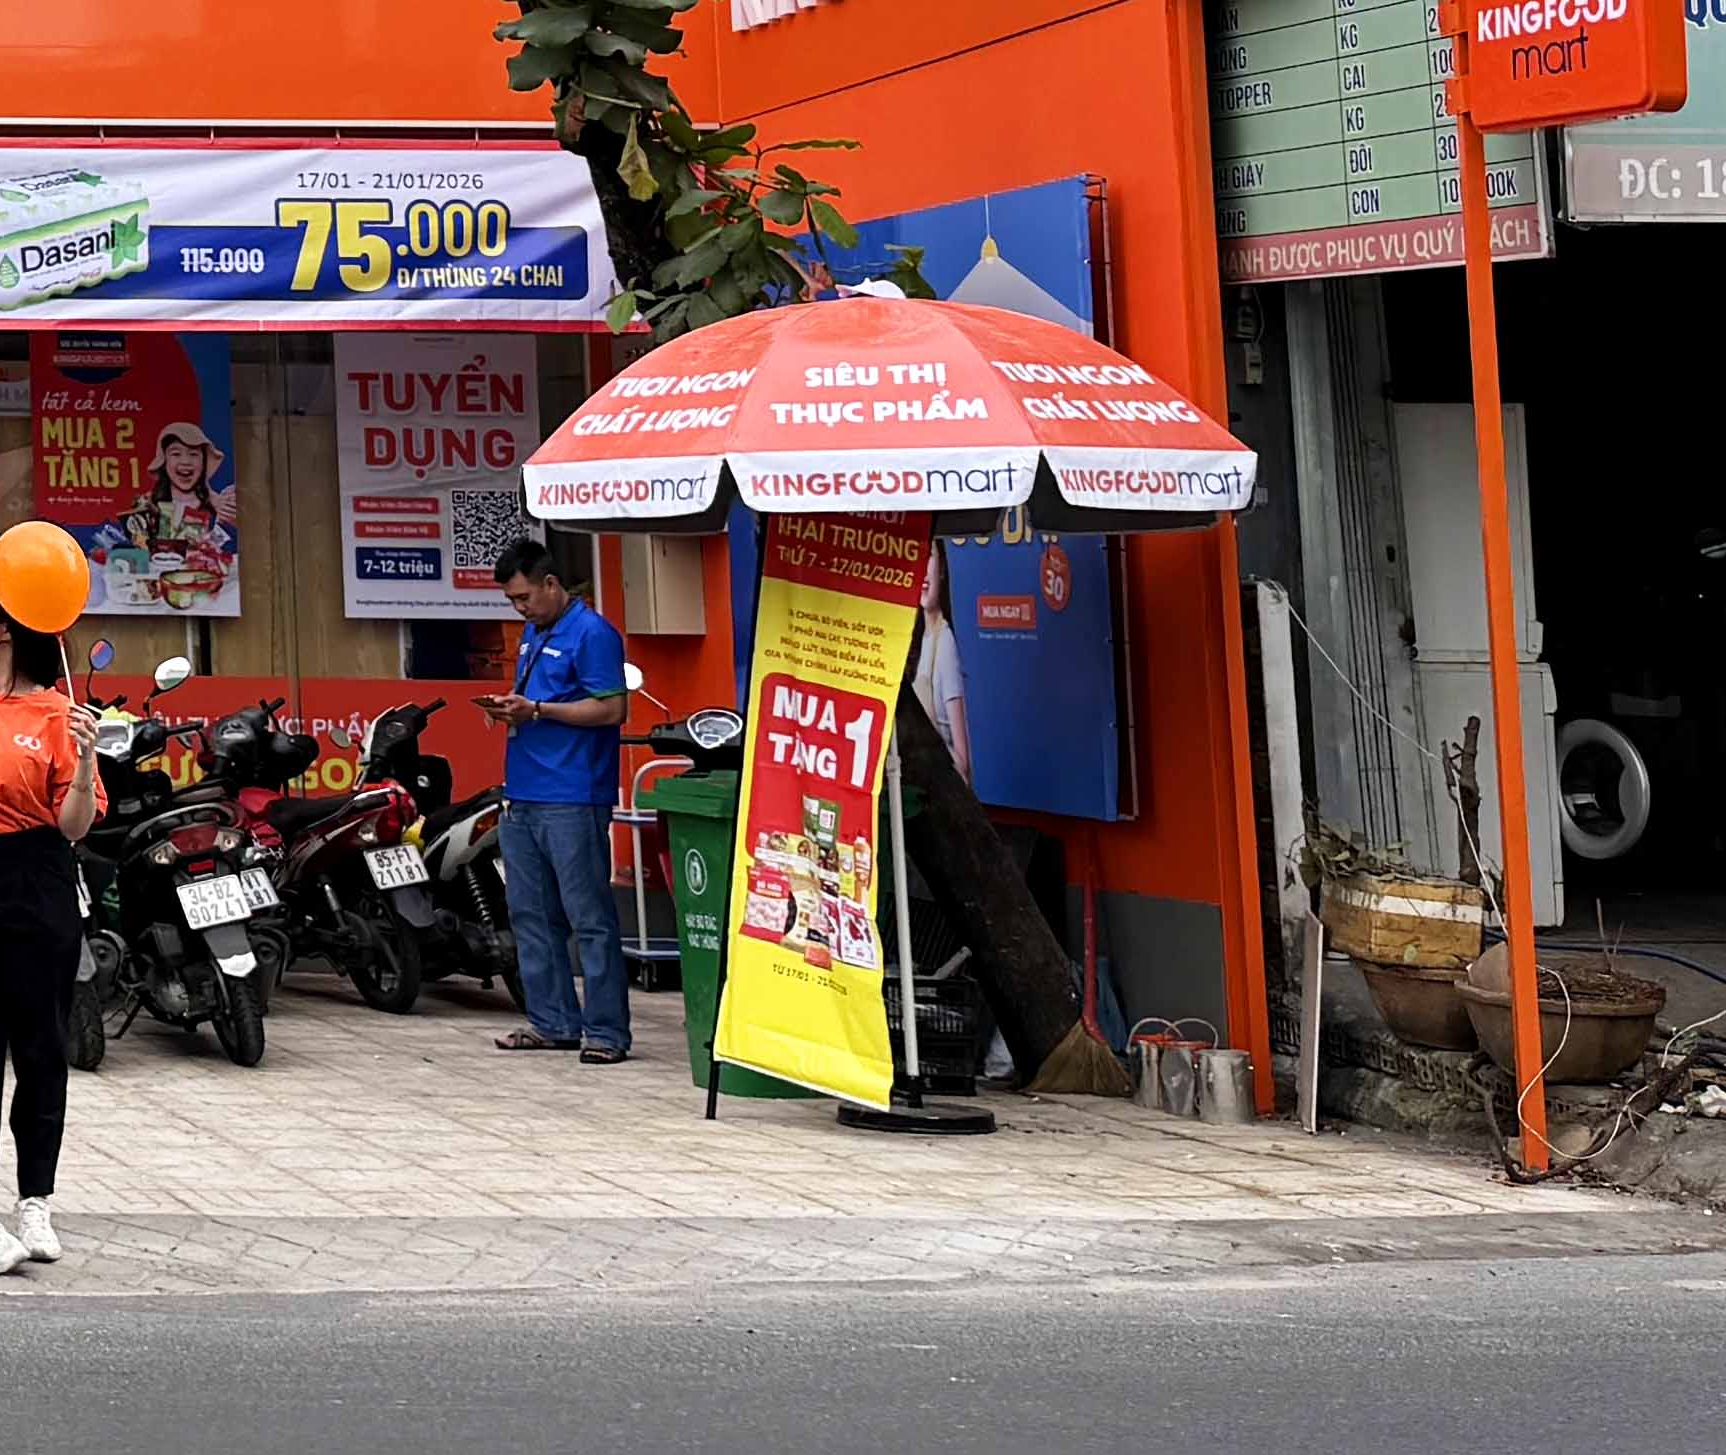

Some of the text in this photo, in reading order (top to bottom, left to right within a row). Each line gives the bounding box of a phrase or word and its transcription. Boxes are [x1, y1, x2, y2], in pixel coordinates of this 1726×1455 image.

[1340, 24, 1359, 50] KG
[1512, 27, 1589, 81] mart
[1219, 82, 1364, 132] TOPPER KG
[1349, 145, 1373, 173] ĐÔI
[297, 172, 484, 190] 17/01 21/01/2026
[1619, 158, 1682, 199] ĐC:
[1352, 189, 1380, 215] CON
[20, 222, 116, 274] Dasani
[274, 196, 507, 292] 75.000
[1269, 220, 1456, 275] ĐƯỢC PHỤC VỤ QUÝ
[397, 256, 565, 290] Đ/THÙNG 24 CHAI
[348, 354, 524, 414] TUYỂN
[804, 360, 947, 392] SIÊU THỊ
[101, 390, 143, 411] kem
[770, 389, 989, 429] THỰC PHẨM
[42, 417, 135, 449] MUA 2
[44, 449, 140, 493] TẶNG 1
[364, 427, 516, 479] DỤNG
[538, 470, 709, 508] KINGFOODmart
[750, 463, 1018, 498] KINGFOODmart
[1059, 463, 1243, 499] KINGFOODmart
[828, 525, 920, 563] TRƯƠNG
[364, 558, 434, 577] 7-12 triệu
[830, 556, 915, 590] 17/01/2026
[1045, 569, 1064, 601] 30
[771, 684, 838, 734] MUA
[767, 730, 838, 783] TẶNG
[844, 708, 875, 790] 1
[379, 864, 425, 886] 211.81
[190, 901, 244, 925] 902.41
